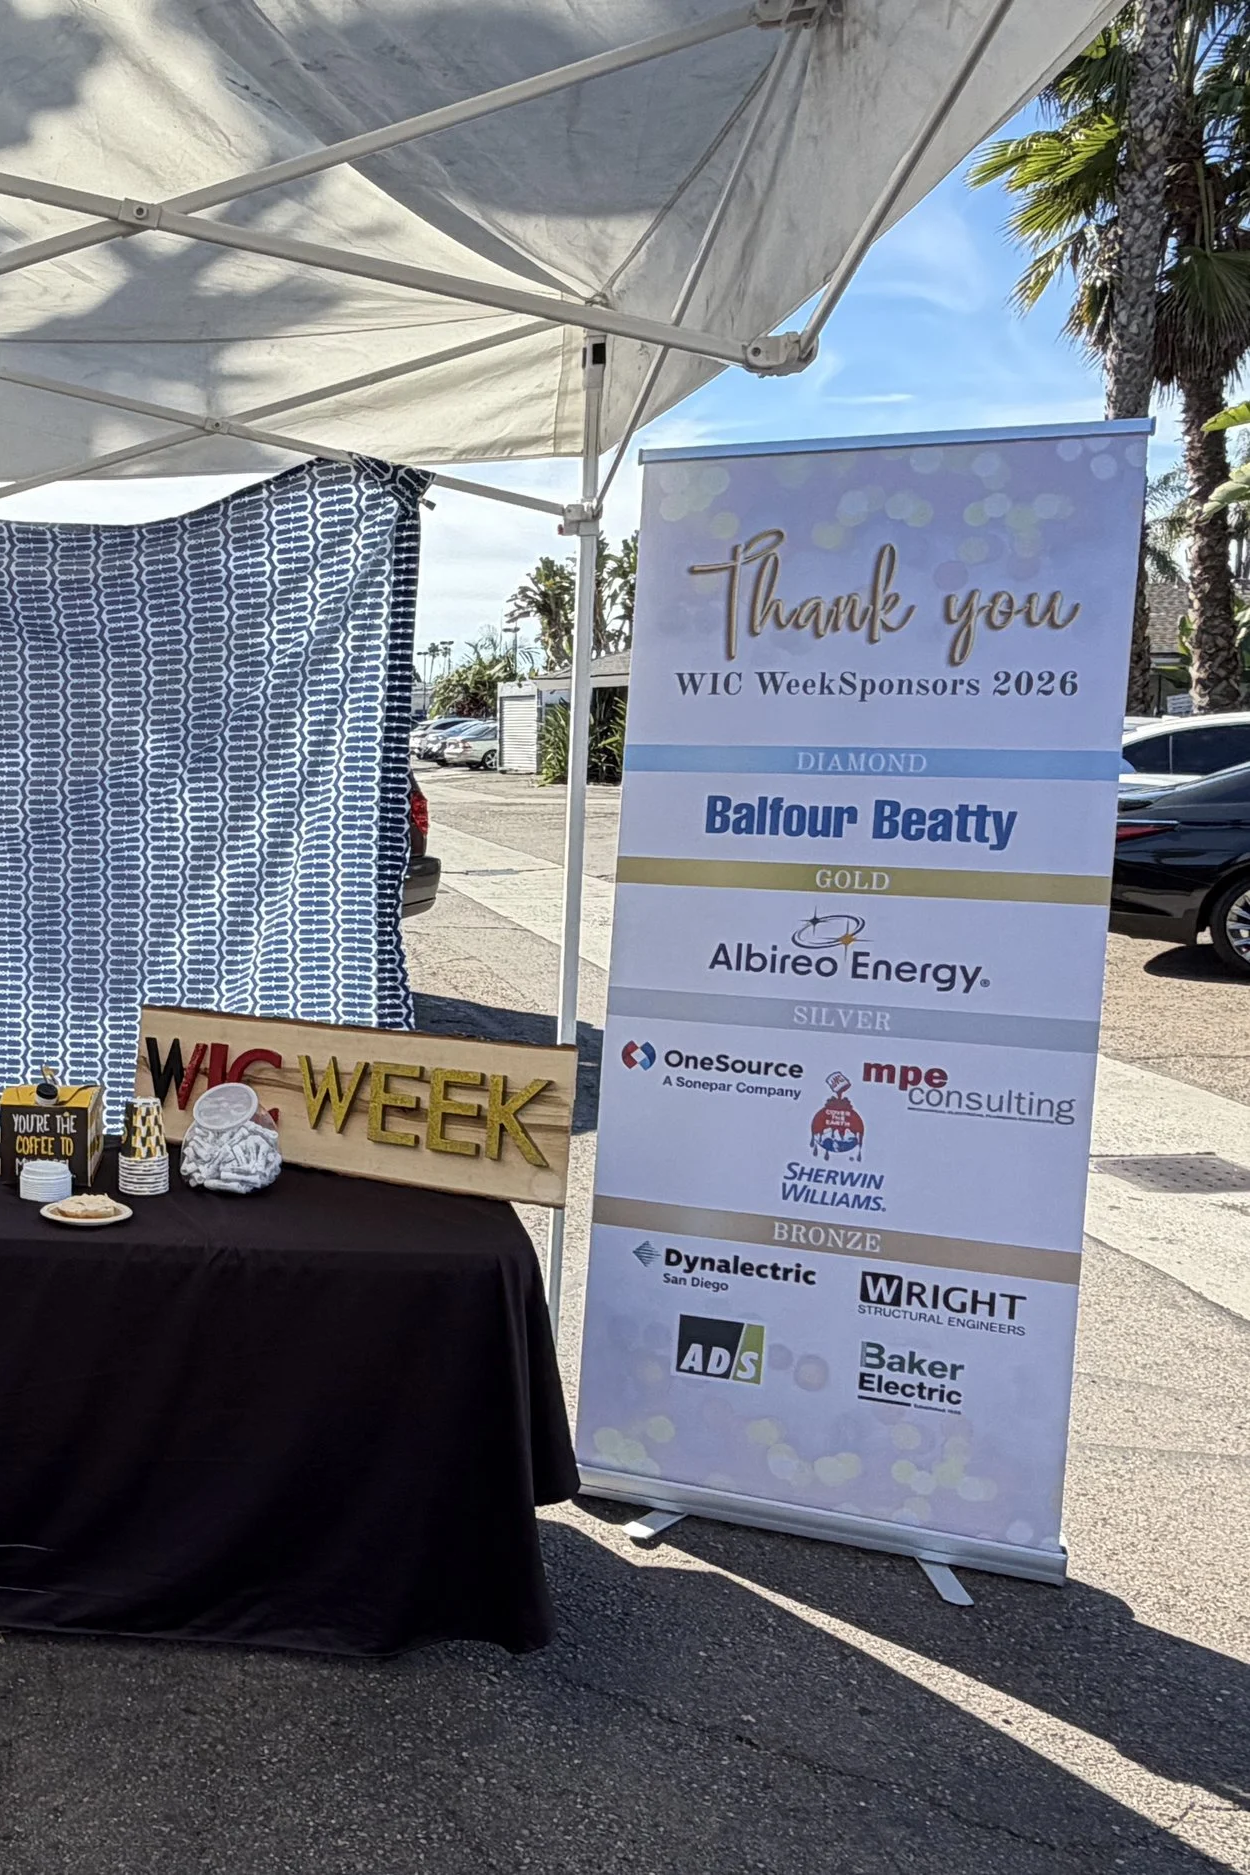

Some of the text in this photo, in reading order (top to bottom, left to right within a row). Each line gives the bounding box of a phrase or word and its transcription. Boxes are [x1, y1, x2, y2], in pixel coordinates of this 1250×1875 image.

[688, 527, 1081, 666] Thank you
[675, 671, 742, 696] WIC
[992, 670, 1079, 696] 2026
[797, 751, 928, 773] DIAMOND
[705, 794, 1018, 851] Balfour Beatty
[815, 869, 891, 891] GOLD
[708, 943, 838, 978] Albireo
[793, 1005, 892, 1032] SILVER
[664, 1049, 803, 1079] OneSource
[862, 1061, 948, 1090] mpe
[662, 1075, 802, 1100] A Sonepar Company
[297, 1054, 555, 1168] WEEK
[908, 1087, 1076, 1125] consulting
[12, 1113, 77, 1134] YOU'RE THE
[16, 1135, 74, 1156] COFFEE TO
[783, 1161, 884, 1190] SHERWIN
[773, 1221, 882, 1253] BRONZE
[662, 1272, 729, 1293] San Diego
[664, 1247, 817, 1286] Dynalectric
[860, 1271, 1027, 1321] WRIGHT
[857, 1303, 1026, 1337] STRUCTURAL ENGINEERS
[679, 1344, 759, 1381] ADS
[860, 1341, 965, 1381] Baker
[858, 1372, 962, 1406] Electric
